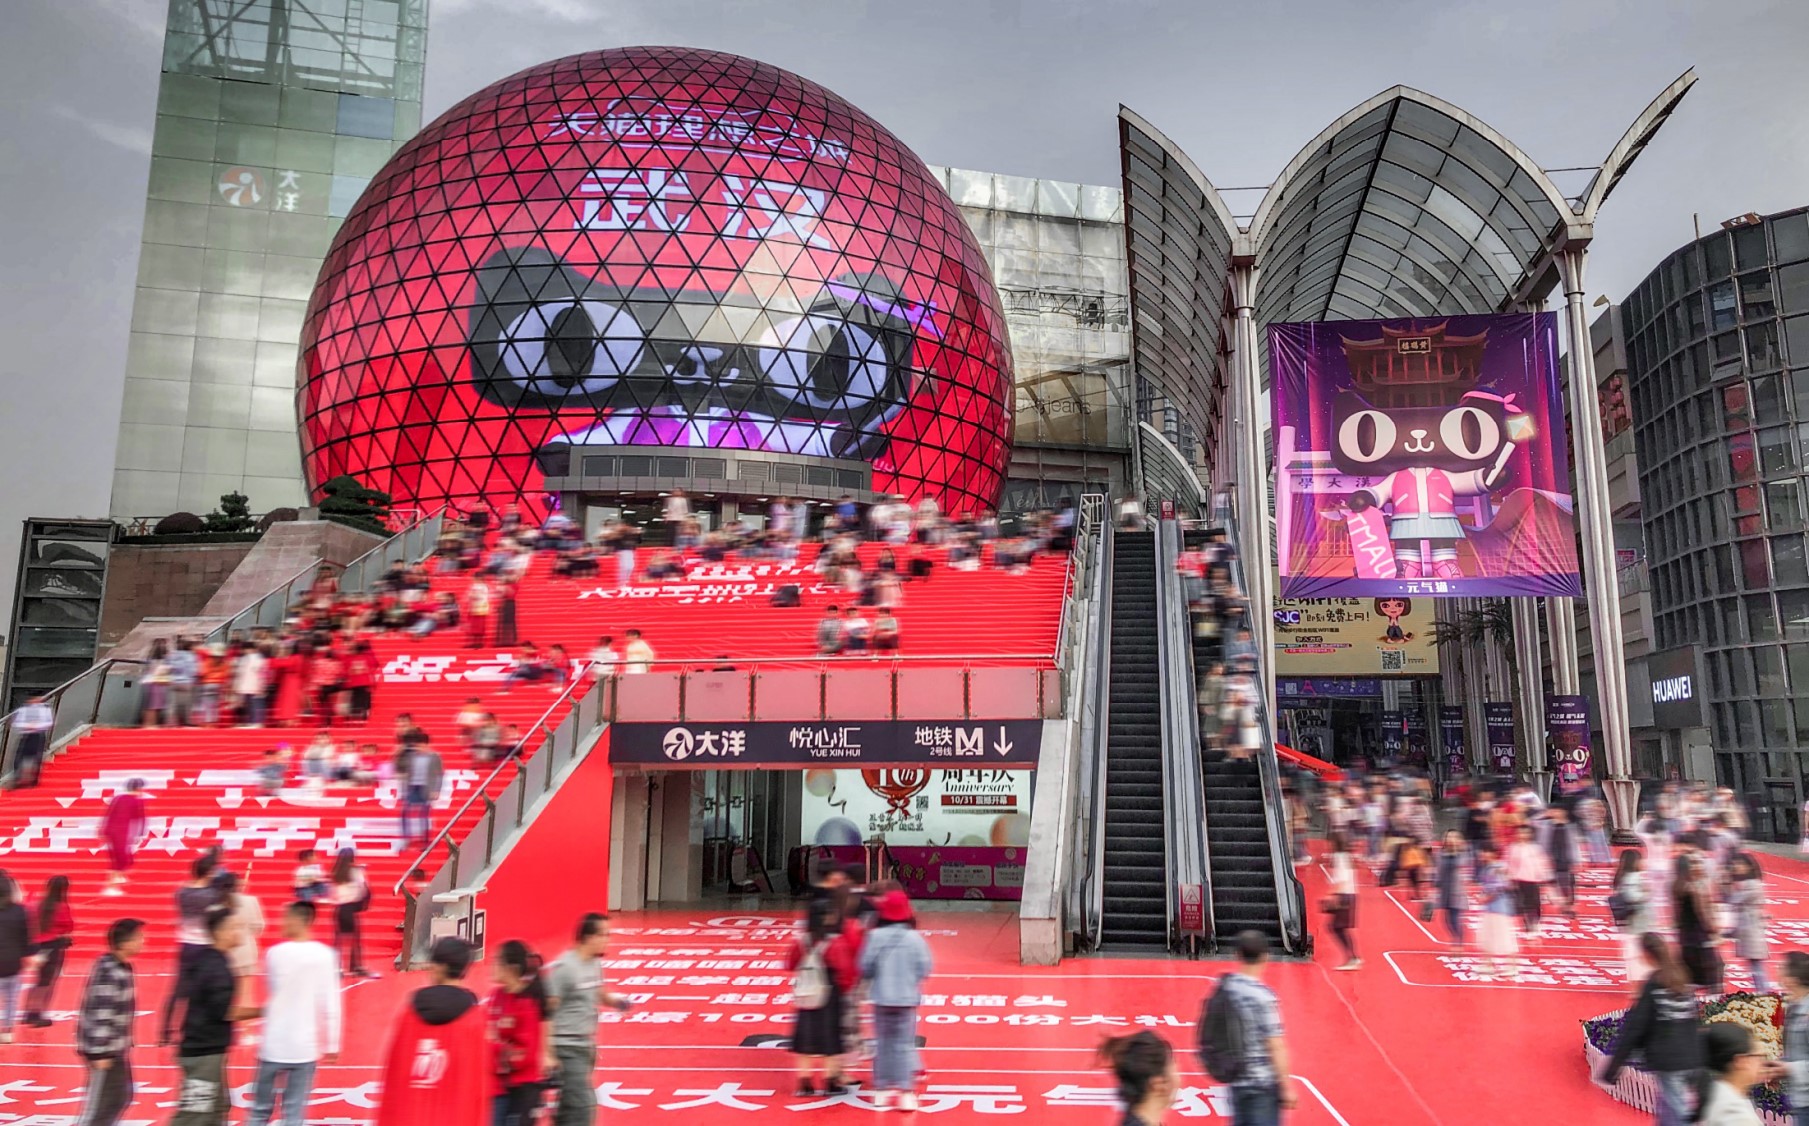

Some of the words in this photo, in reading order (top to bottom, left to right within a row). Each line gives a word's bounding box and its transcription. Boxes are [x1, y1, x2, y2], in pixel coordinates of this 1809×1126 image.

[544, 108, 852, 165] 天猫理想之城
[275, 170, 301, 212] 大洋
[573, 167, 831, 251] 武汉
[1048, 396, 1092, 415] jeans
[1407, 582, 1449, 593] 元气猫
[1653, 676, 1692, 703] HUAWEI
[695, 730, 746, 757] 大洋
[789, 727, 862, 749] 悦心汇
[915, 726, 952, 746] 地铁
[810, 749, 829, 757] YUE
[830, 749, 844, 757] XIN
[845, 749, 861, 757] HUI
[929, 747, 952, 757] 2号线
[943, 780, 1014, 793] Anniversary
[950, 796, 973, 805] 10/31
